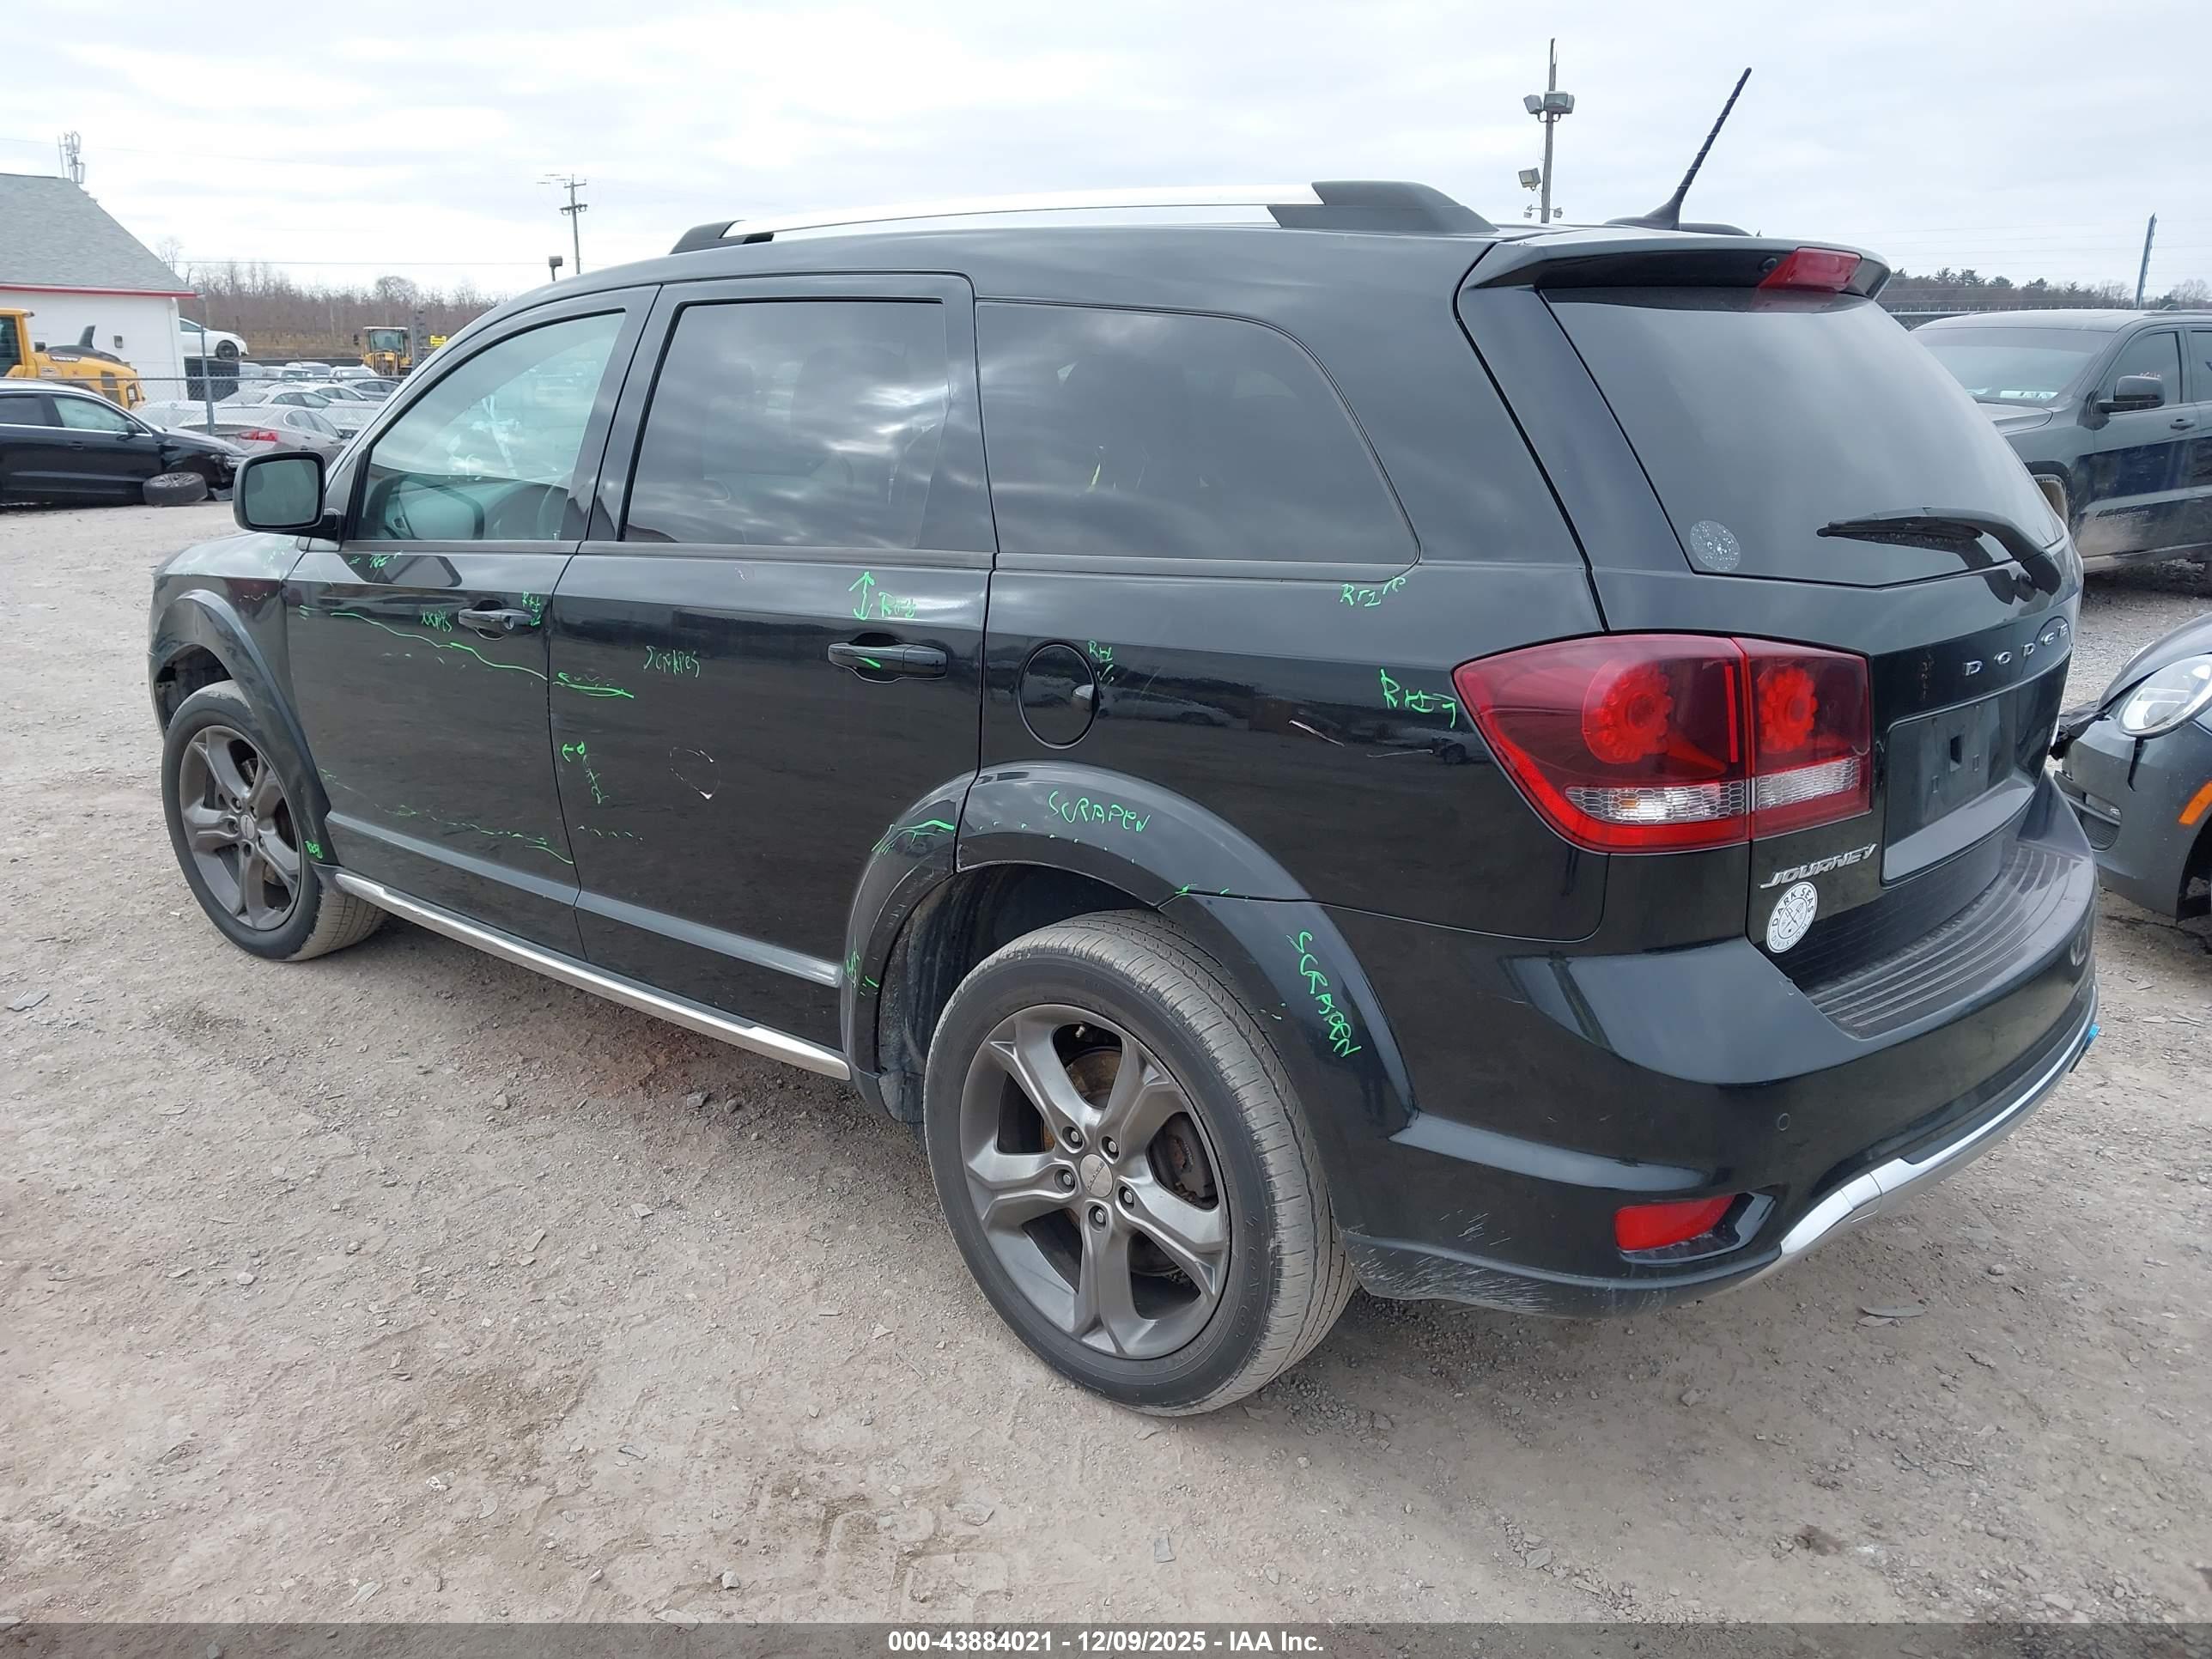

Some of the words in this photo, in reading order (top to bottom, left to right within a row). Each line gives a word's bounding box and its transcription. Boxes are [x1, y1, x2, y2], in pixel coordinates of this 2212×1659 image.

[1963, 623, 2069, 676] DODGE
[1759, 842, 1878, 890] JOURNEY
[1771, 890, 1797, 927] DARK
[1800, 886, 1815, 913] SEAS
